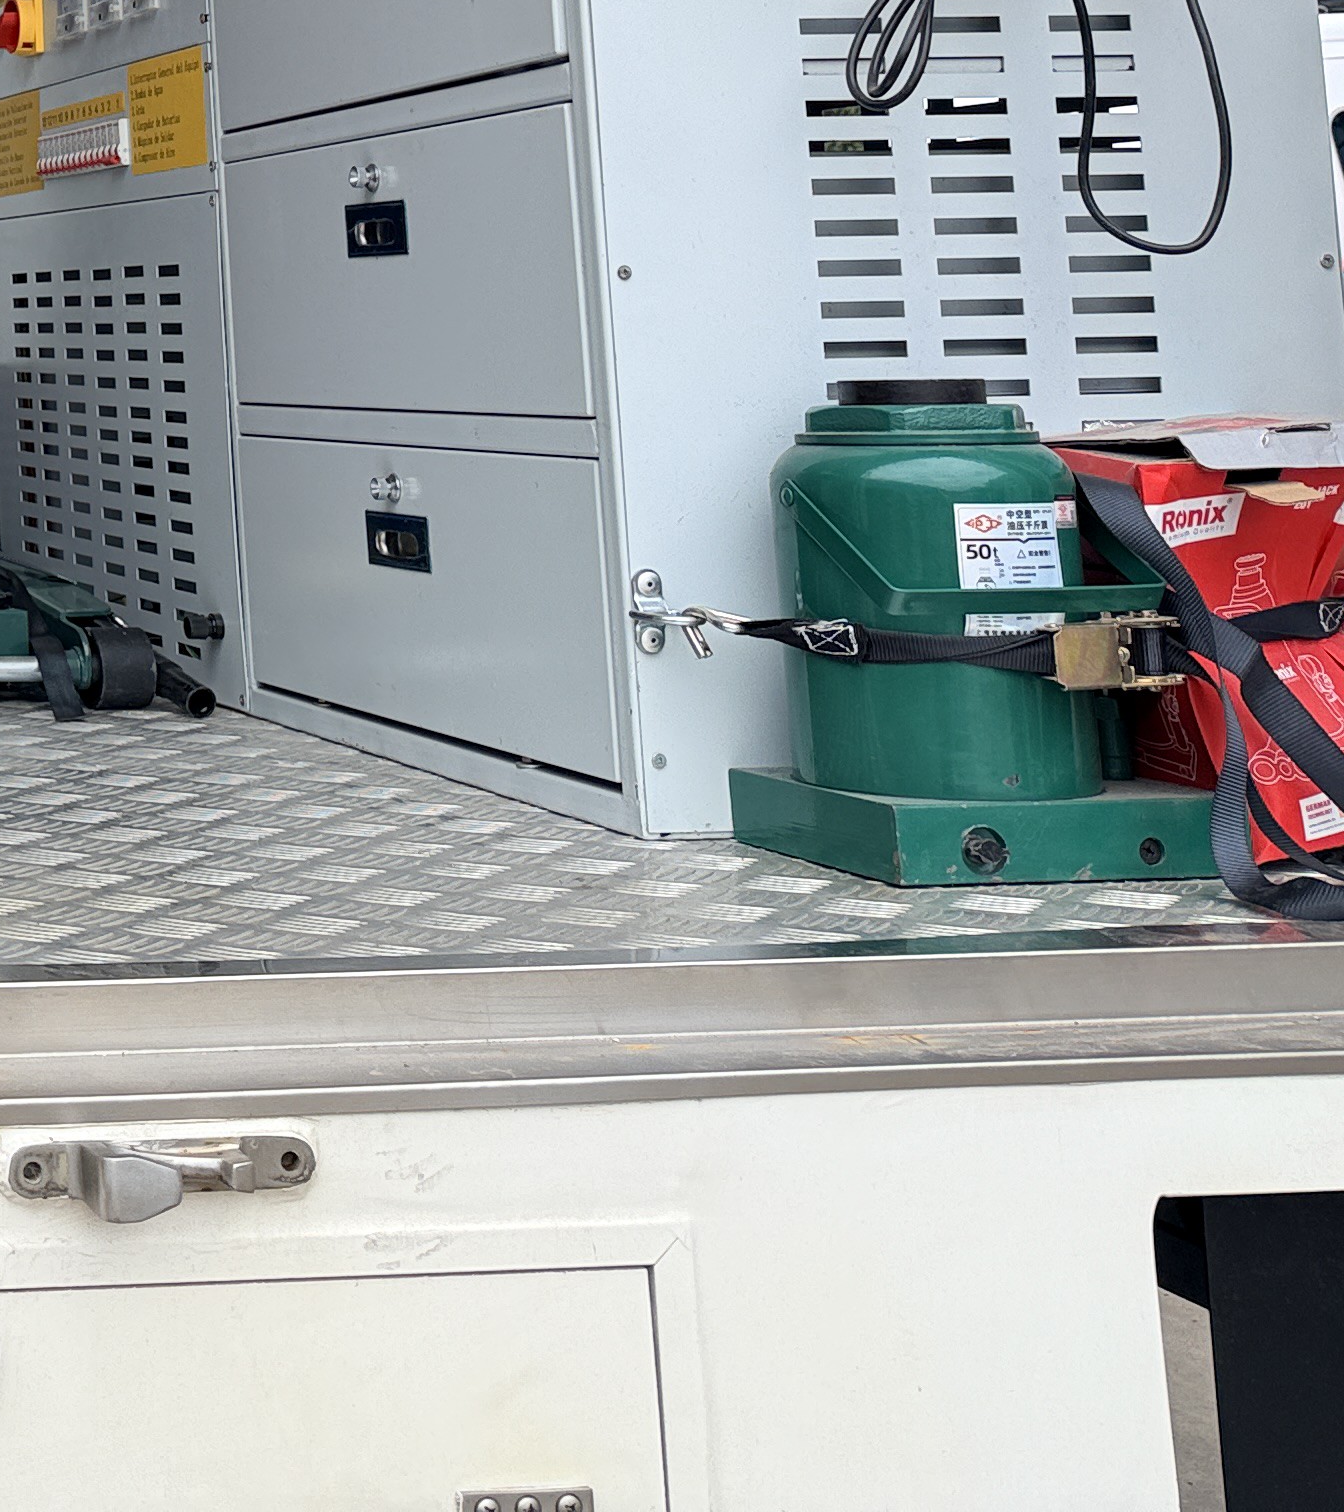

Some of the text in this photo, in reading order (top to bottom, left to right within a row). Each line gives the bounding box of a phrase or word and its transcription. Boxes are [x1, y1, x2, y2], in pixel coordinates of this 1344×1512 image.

[1162, 499, 1228, 535] Ronix
[1193, 524, 1225, 536] Quality
[966, 543, 999, 560] 50t
[1274, 662, 1298, 681] nix
